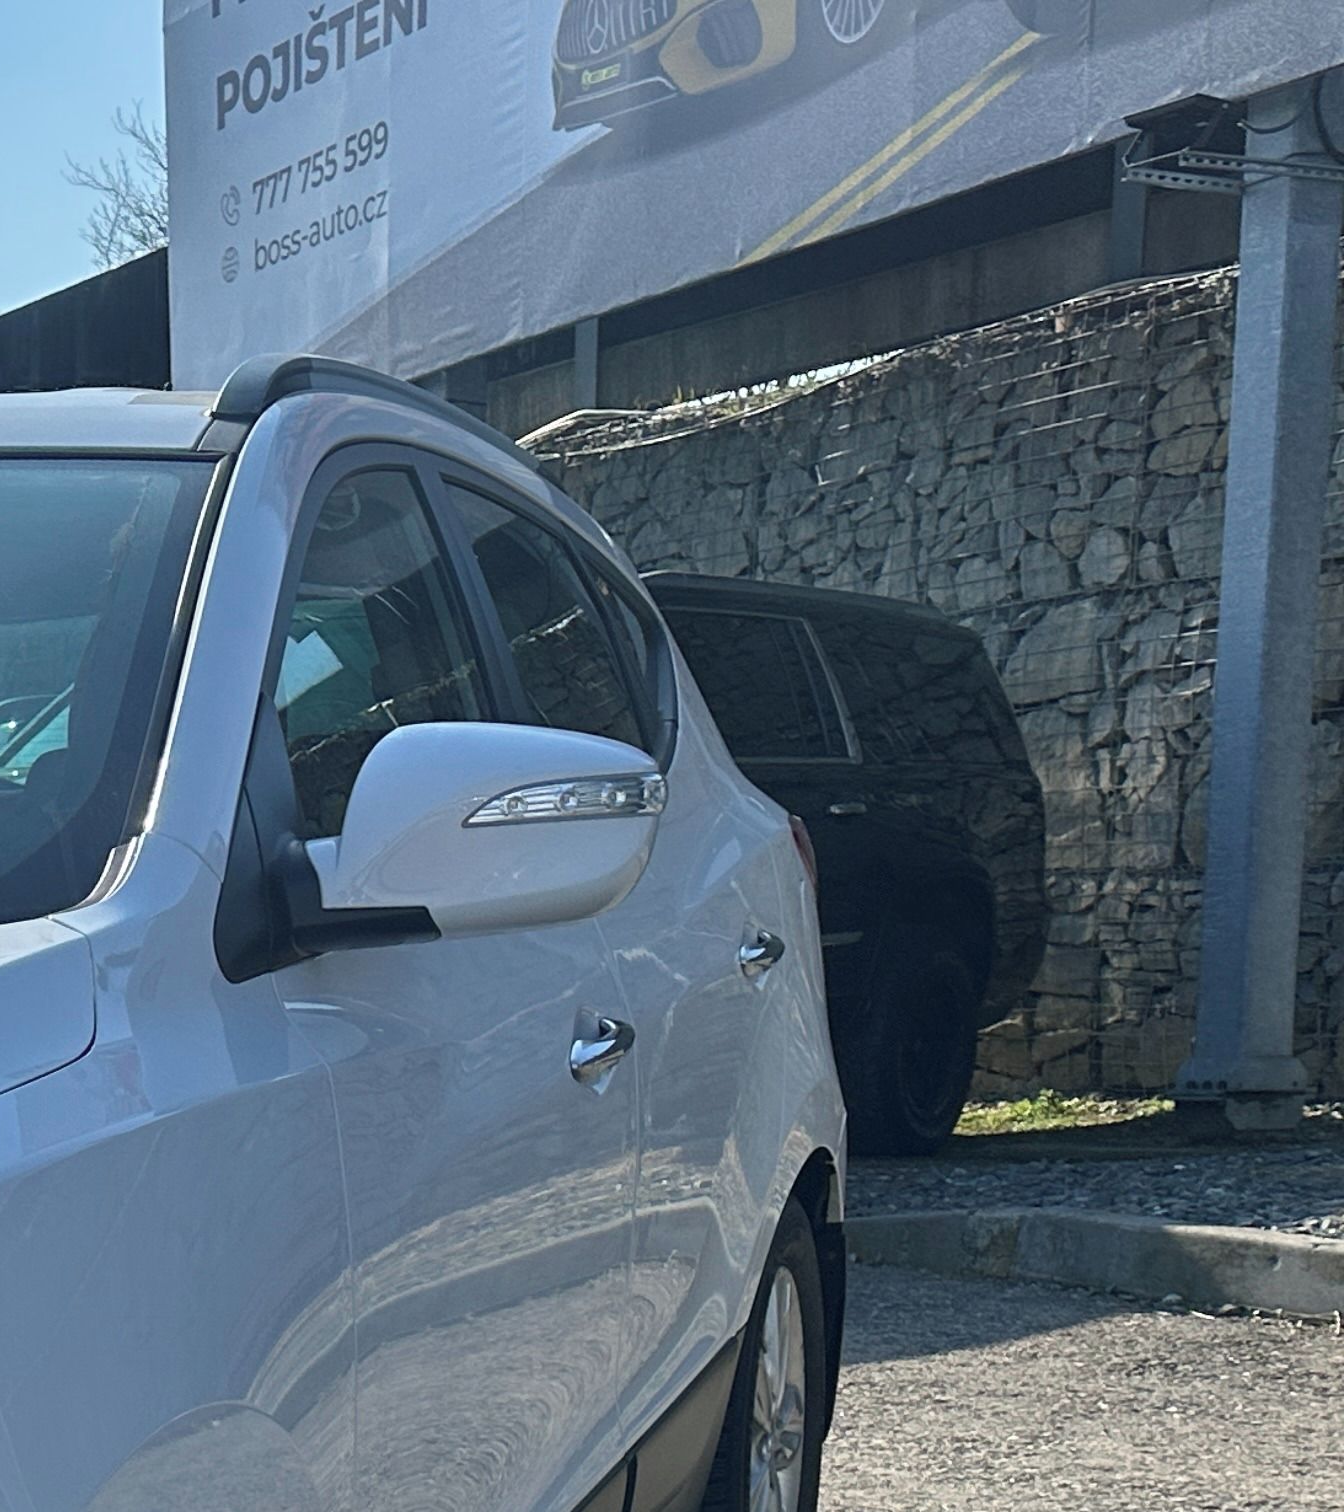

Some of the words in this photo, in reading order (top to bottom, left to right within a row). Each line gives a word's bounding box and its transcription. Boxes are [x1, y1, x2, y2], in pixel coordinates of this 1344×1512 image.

[252, 165, 292, 215] 777
[298, 143, 338, 195] 755
[343, 121, 389, 173] 599
[254, 190, 388, 272] boss-auto.cz
